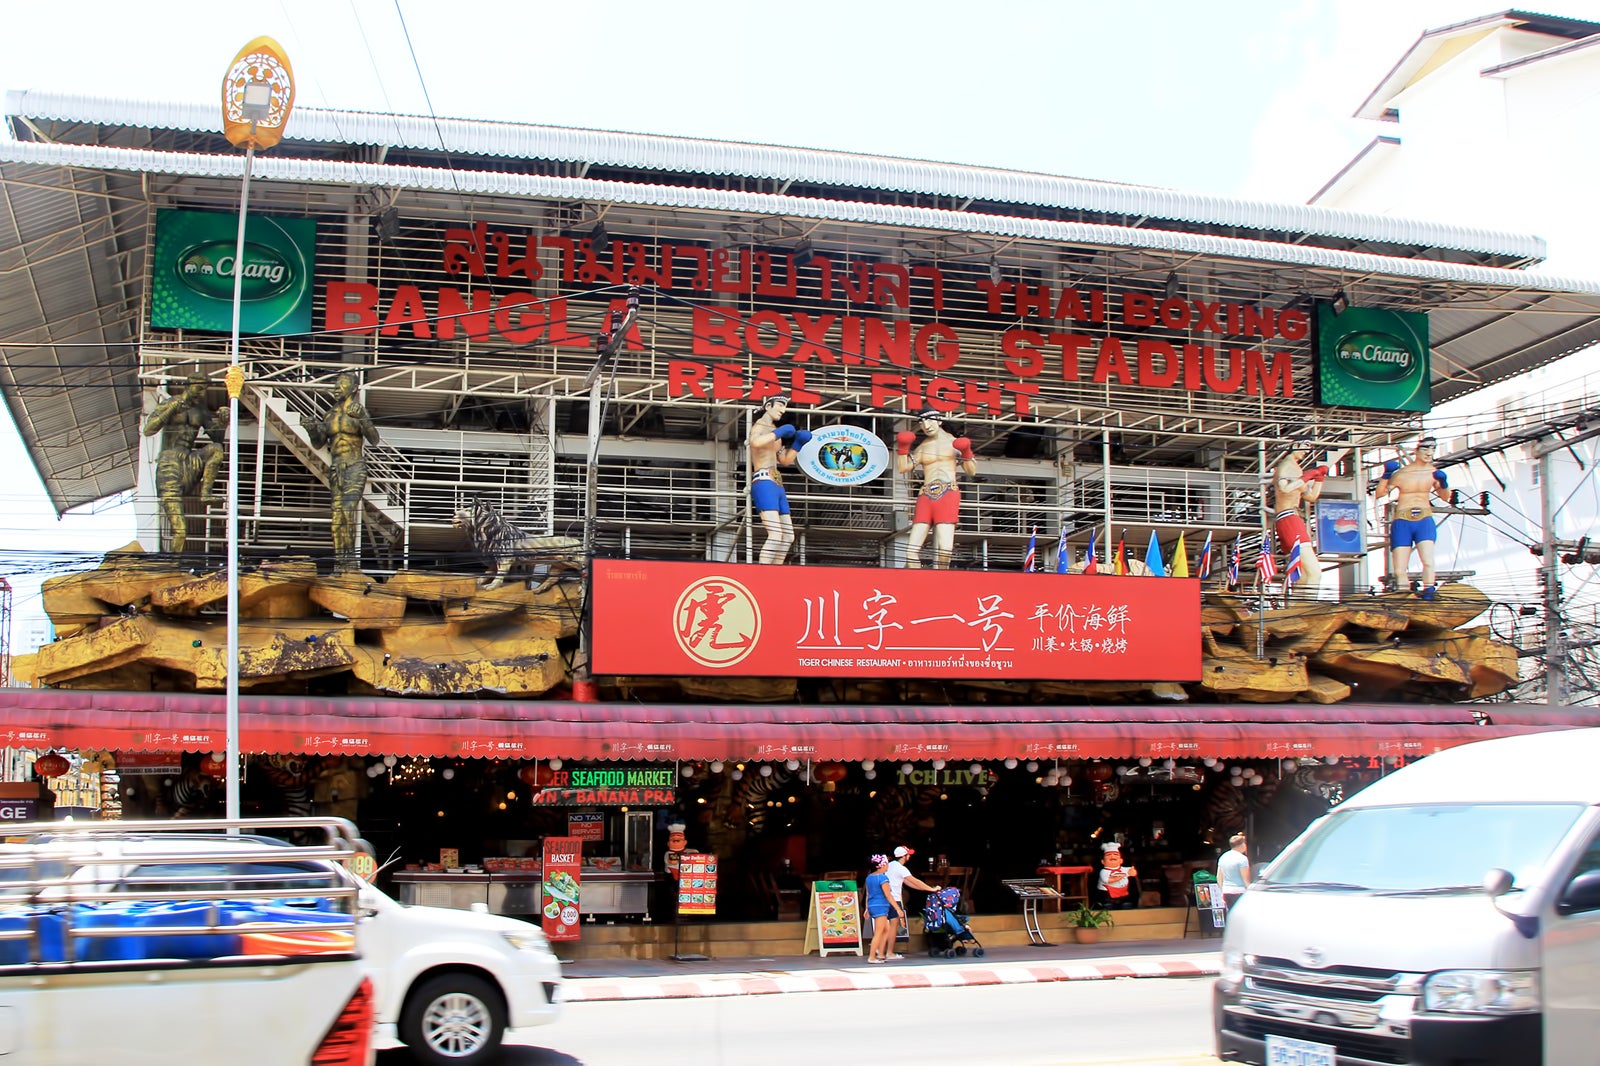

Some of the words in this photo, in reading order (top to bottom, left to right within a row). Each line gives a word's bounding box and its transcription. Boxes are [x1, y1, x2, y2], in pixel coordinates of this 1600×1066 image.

[443, 220, 943, 312] สนามมวยบางลา
[976, 280, 1104, 323] THAI
[1123, 292, 1308, 340] BOXING
[325, 281, 645, 351] BANGLA
[692, 305, 960, 371] BOXING
[1000, 329, 1294, 398] STADIUM
[1362, 345, 1409, 367] Chang
[668, 360, 821, 404] REAL
[871, 372, 1040, 417] FIGHT
[810, 460, 825, 477] WORLD
[856, 464, 877, 481] COUNCIL
[796, 589, 1014, 652] 川字一号
[1027, 603, 1132, 634] 平价海鲜
[799, 658, 820, 667] TIGER
[821, 658, 853, 667] CHINESE
[856, 659, 901, 667] RESTAURANT
[547, 771, 569, 786] ER
[572, 771, 624, 786] SEAFOOD
[627, 771, 673, 786] MARKET
[943, 770, 988, 785] LIVE
[576, 790, 639, 804] BANANA
[545, 841, 580, 853] SEAFOOD
[551, 854, 575, 863] BASKET
